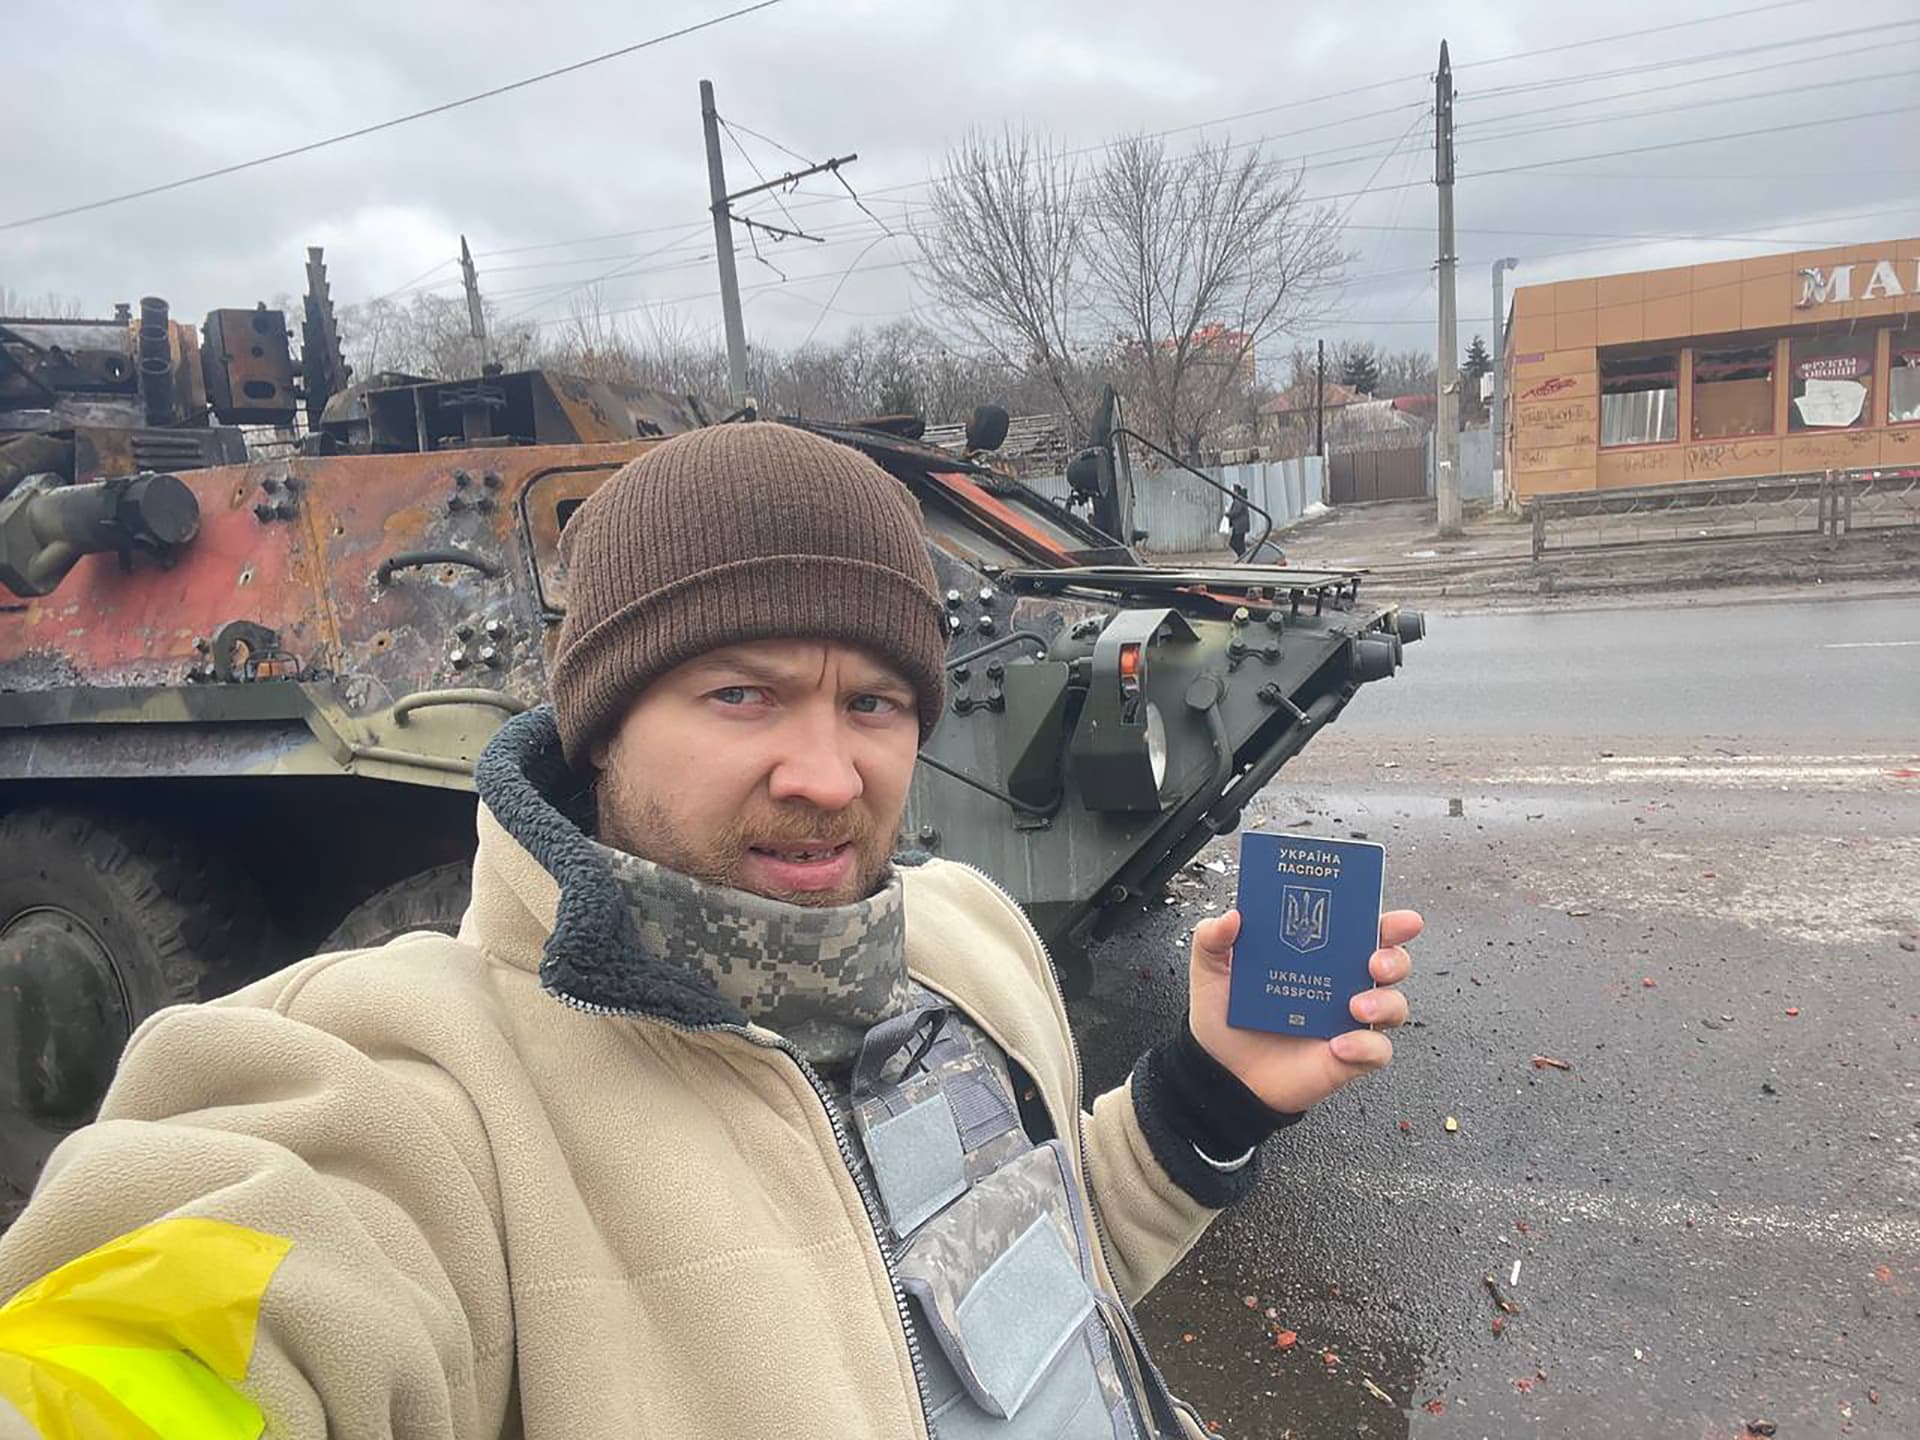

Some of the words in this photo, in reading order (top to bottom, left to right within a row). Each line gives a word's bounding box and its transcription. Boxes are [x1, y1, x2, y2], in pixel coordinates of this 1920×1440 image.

[1280, 848, 1341, 864] УКРАЇНА
[1278, 862, 1340, 879] ПАСПОРТ
[1269, 969, 1332, 988] UKRAINE
[1265, 983, 1333, 1001] PASSPORT
